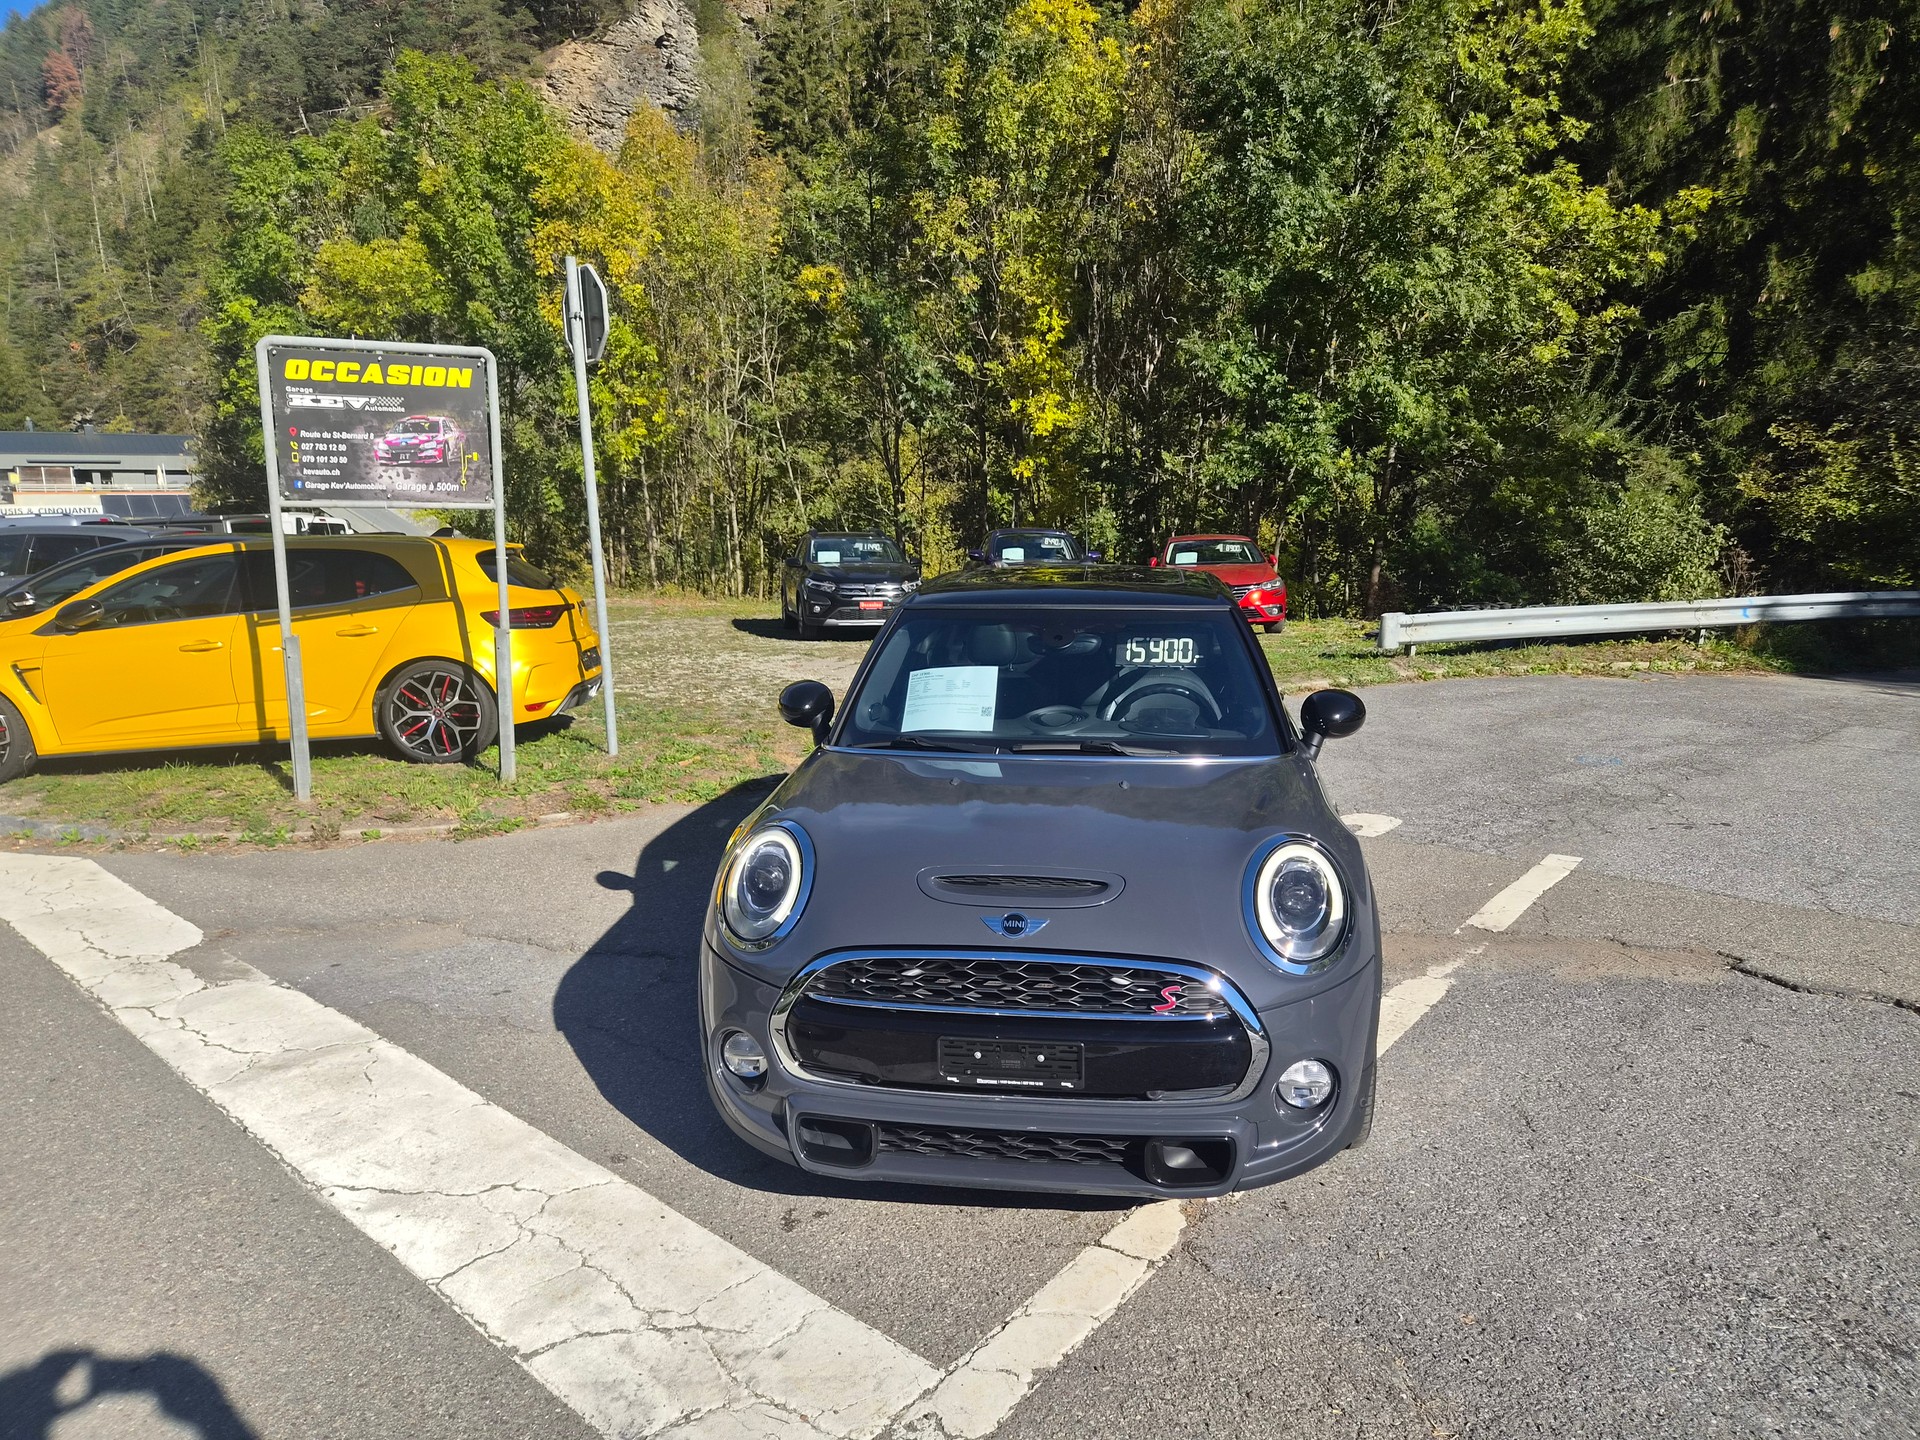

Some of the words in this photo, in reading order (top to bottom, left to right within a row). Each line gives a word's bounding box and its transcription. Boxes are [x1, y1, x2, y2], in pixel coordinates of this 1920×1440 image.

[284, 358, 473, 388] OCCASION
[285, 385, 314, 394] Garage
[364, 404, 406, 413] Automobile
[300, 429, 321, 439] Route
[322, 430, 332, 439] du
[332, 431, 368, 440] St-Bernard
[301, 442, 314, 451] 027
[329, 443, 337, 451] 12
[302, 455, 315, 463] 079
[316, 455, 328, 463] 101
[329, 455, 338, 463] 30
[303, 467, 341, 476] kevauto.ch
[304, 481, 330, 490] Garage
[395, 481, 428, 492] Garage
[429, 482, 435, 491] à
[436, 482, 460, 492] 500m
[1003, 920, 1025, 928] MINI
[1151, 985, 1182, 1012] S
